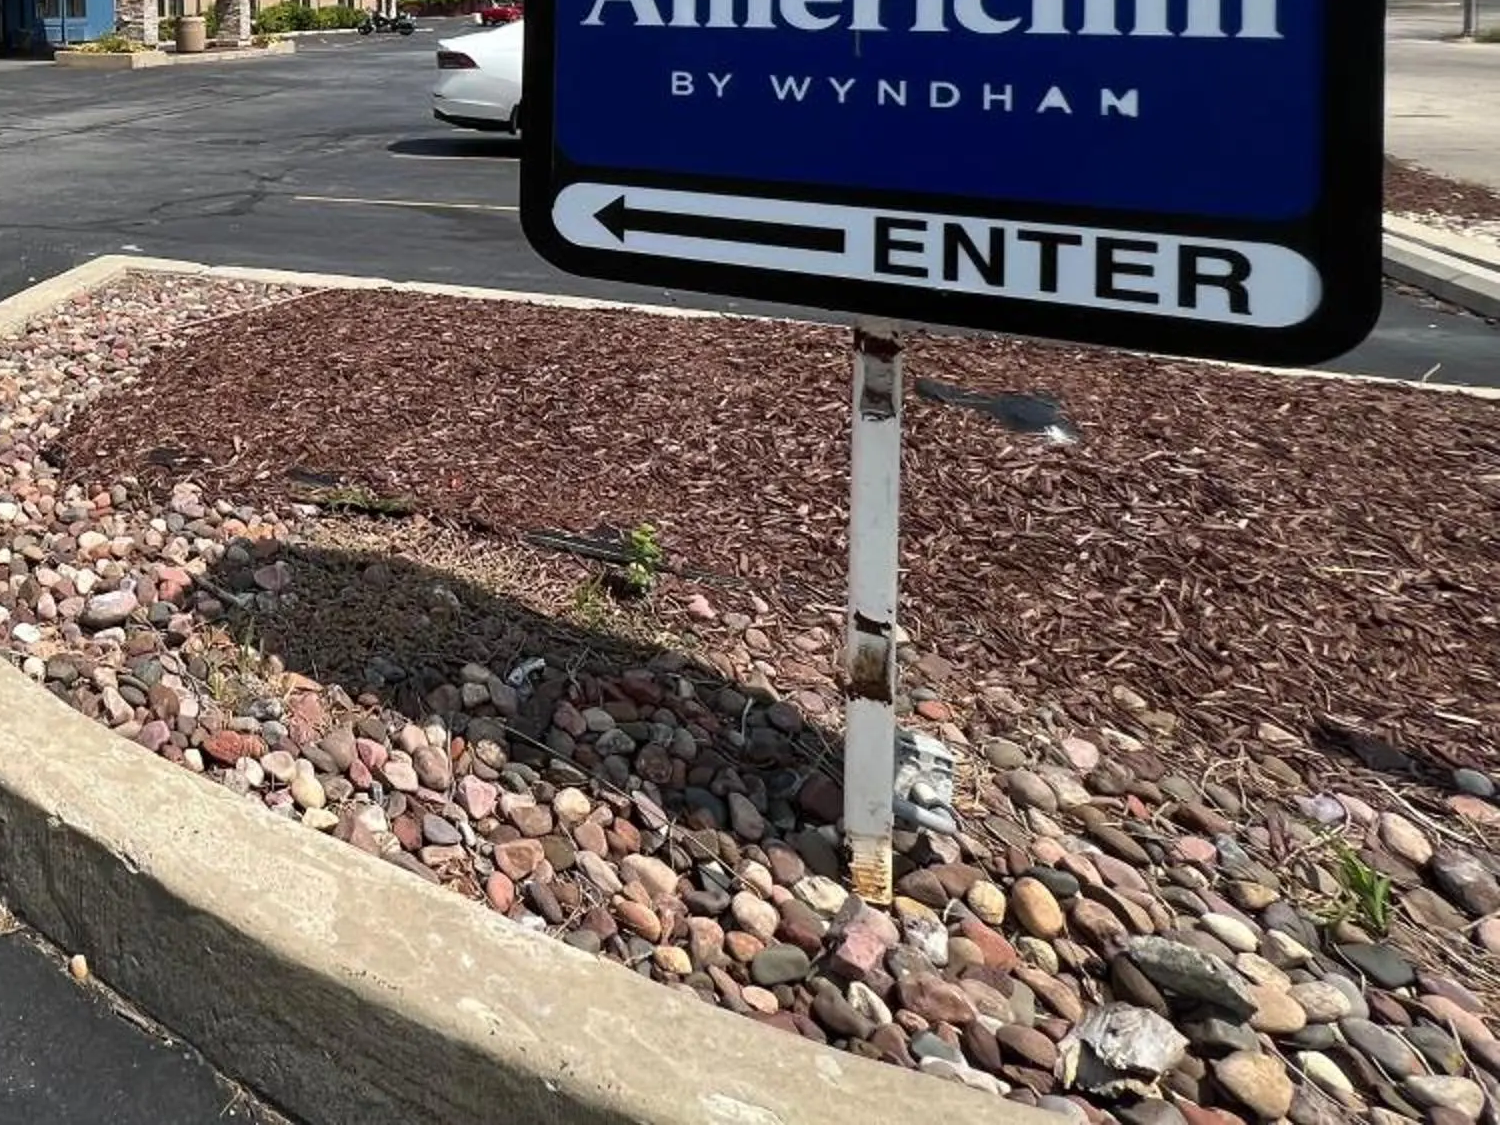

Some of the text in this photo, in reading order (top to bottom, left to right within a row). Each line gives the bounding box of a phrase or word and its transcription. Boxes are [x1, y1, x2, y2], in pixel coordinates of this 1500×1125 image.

[671, 72, 1139, 118] BY WYNDHAM
[873, 216, 1252, 315] ENTER
